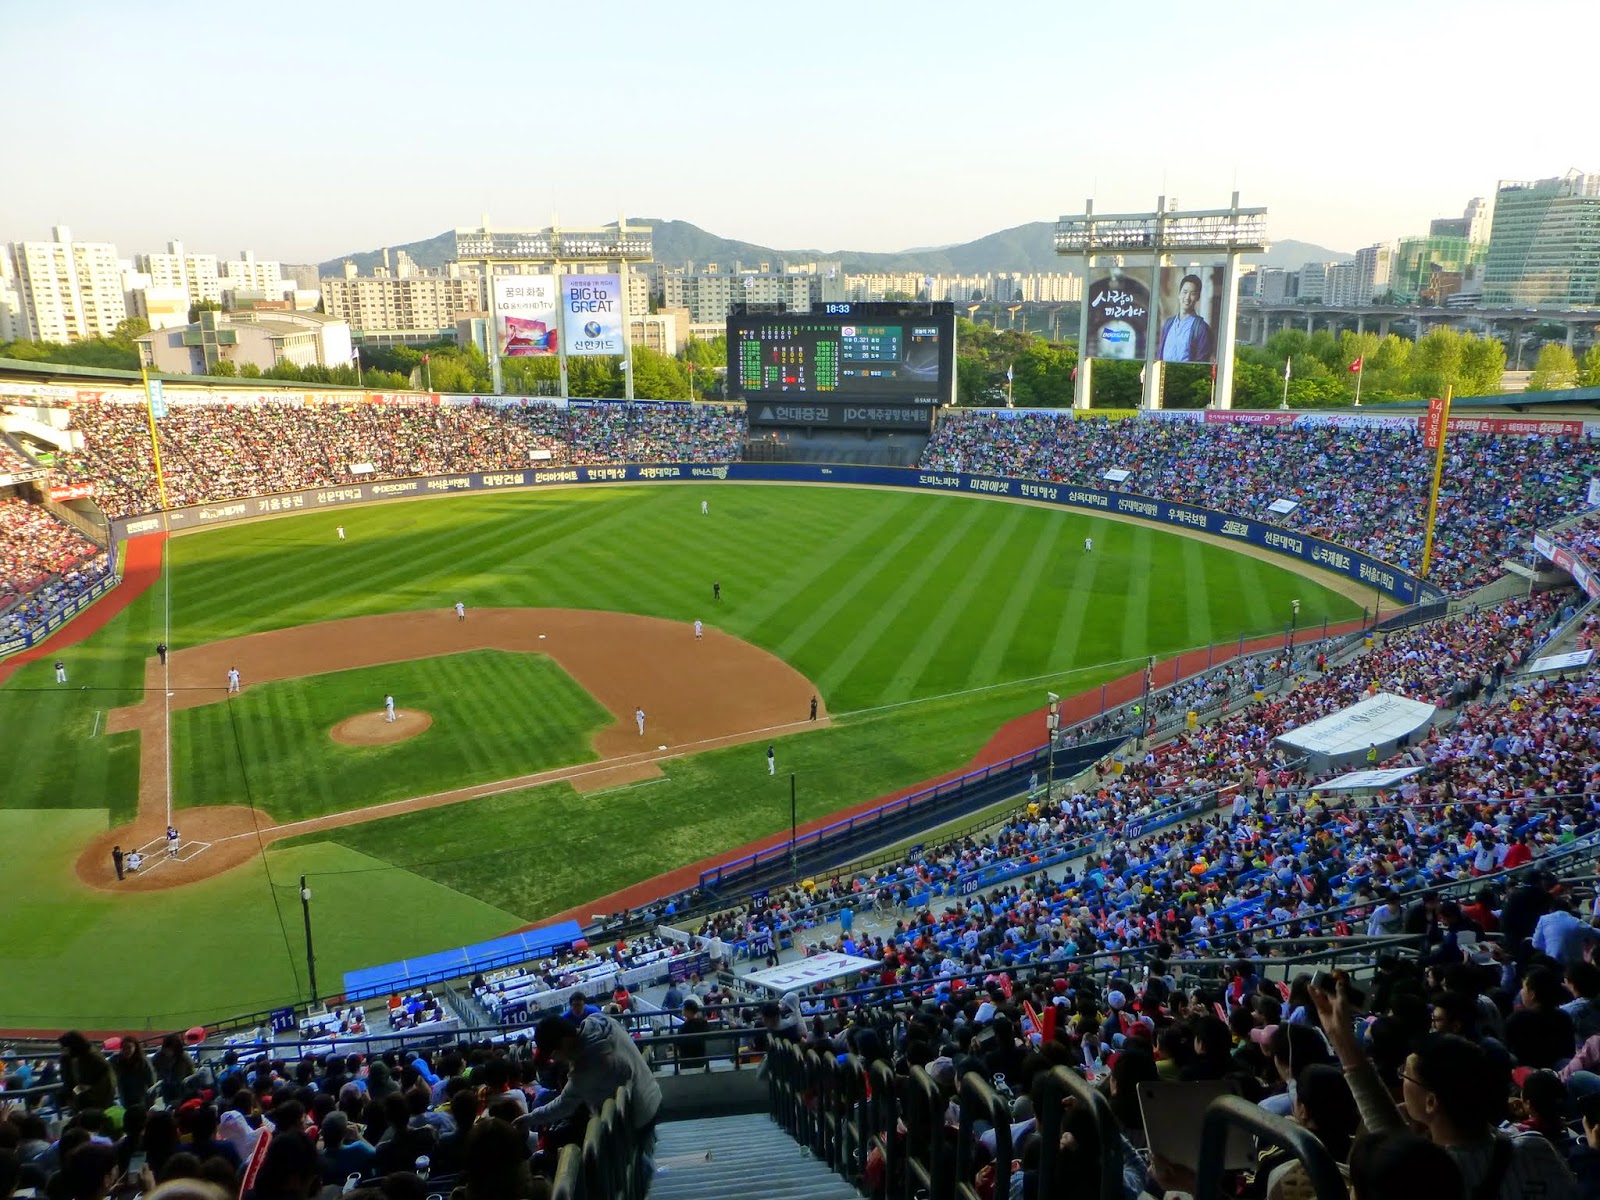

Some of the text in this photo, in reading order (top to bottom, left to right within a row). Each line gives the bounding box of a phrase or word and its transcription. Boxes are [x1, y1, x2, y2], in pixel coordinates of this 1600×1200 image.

[505, 287, 545, 297] 꿈의 화질
[570, 288, 606, 300] BIG to
[1092, 290, 1134, 307] 사람이
[572, 300, 613, 312] GREAT
[826, 304, 850, 313] 18:33
[1104, 306, 1146, 317] 미래다
[574, 340, 614, 351] 신한카드
[776, 407, 829, 421] 현대증권
[844, 408, 928, 422] JDC 제주공항면세점
[1508, 423, 1537, 431] 해태제과
[483, 473, 524, 485] 대방건설
[535, 471, 578, 482] 인디아게이트
[588, 467, 626, 479] 현대해상
[639, 468, 680, 478] 서경대학교
[380, 482, 417, 492] DESCENTE
[919, 475, 960, 488] 도미노피자
[970, 479, 1009, 494] 미래에셋
[316, 487, 362, 503] 선문대학교
[1021, 484, 1057, 499] 현대해상
[258, 495, 304, 511] 키움증권
[1069, 491, 1108, 506] 삼육대학교
[1168, 508, 1207, 528] 우체국보험
[1264, 532, 1302, 554] 선문대학교
[1128, 825, 1142, 838] 107
[962, 880, 977, 894] 108
[756, 942, 769, 956] 10
[272, 1014, 294, 1029] 111
[503, 1010, 527, 1025] 110
